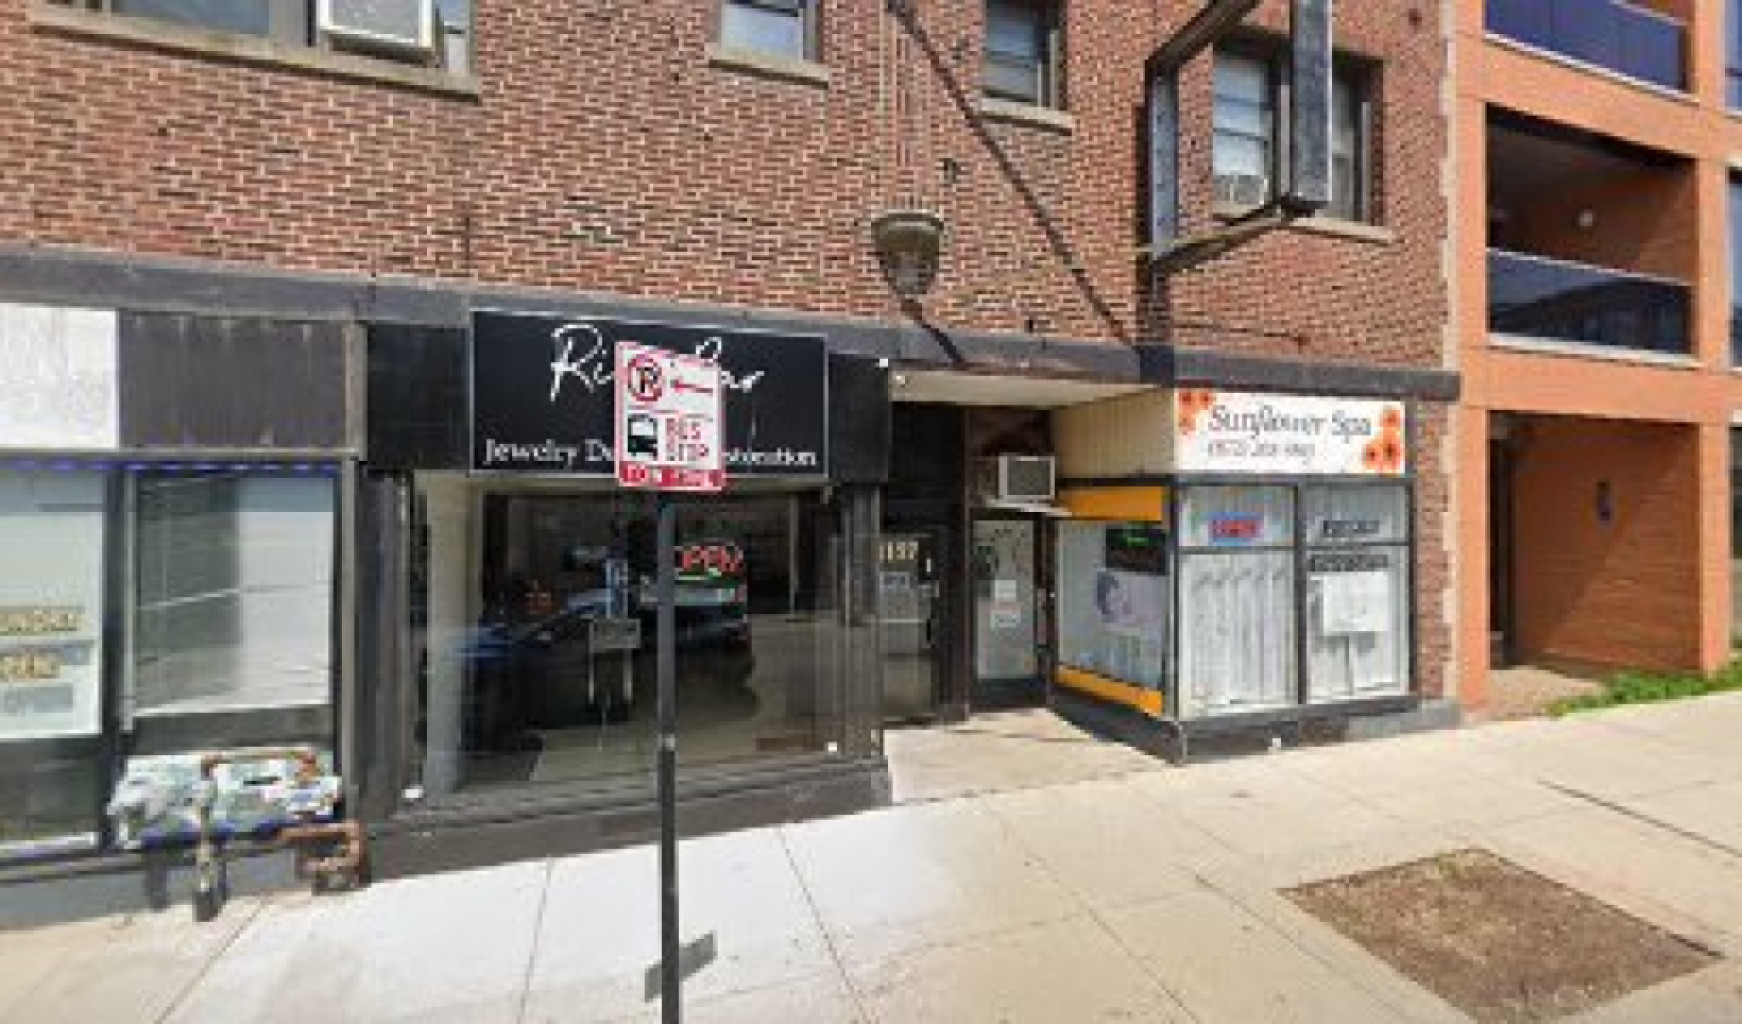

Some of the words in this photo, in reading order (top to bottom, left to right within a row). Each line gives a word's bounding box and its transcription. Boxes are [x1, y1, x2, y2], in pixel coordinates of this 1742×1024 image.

[1208, 403, 1327, 439] Sunflower
[1331, 409, 1372, 444] Spa
[483, 438, 577, 465] Jewelry
